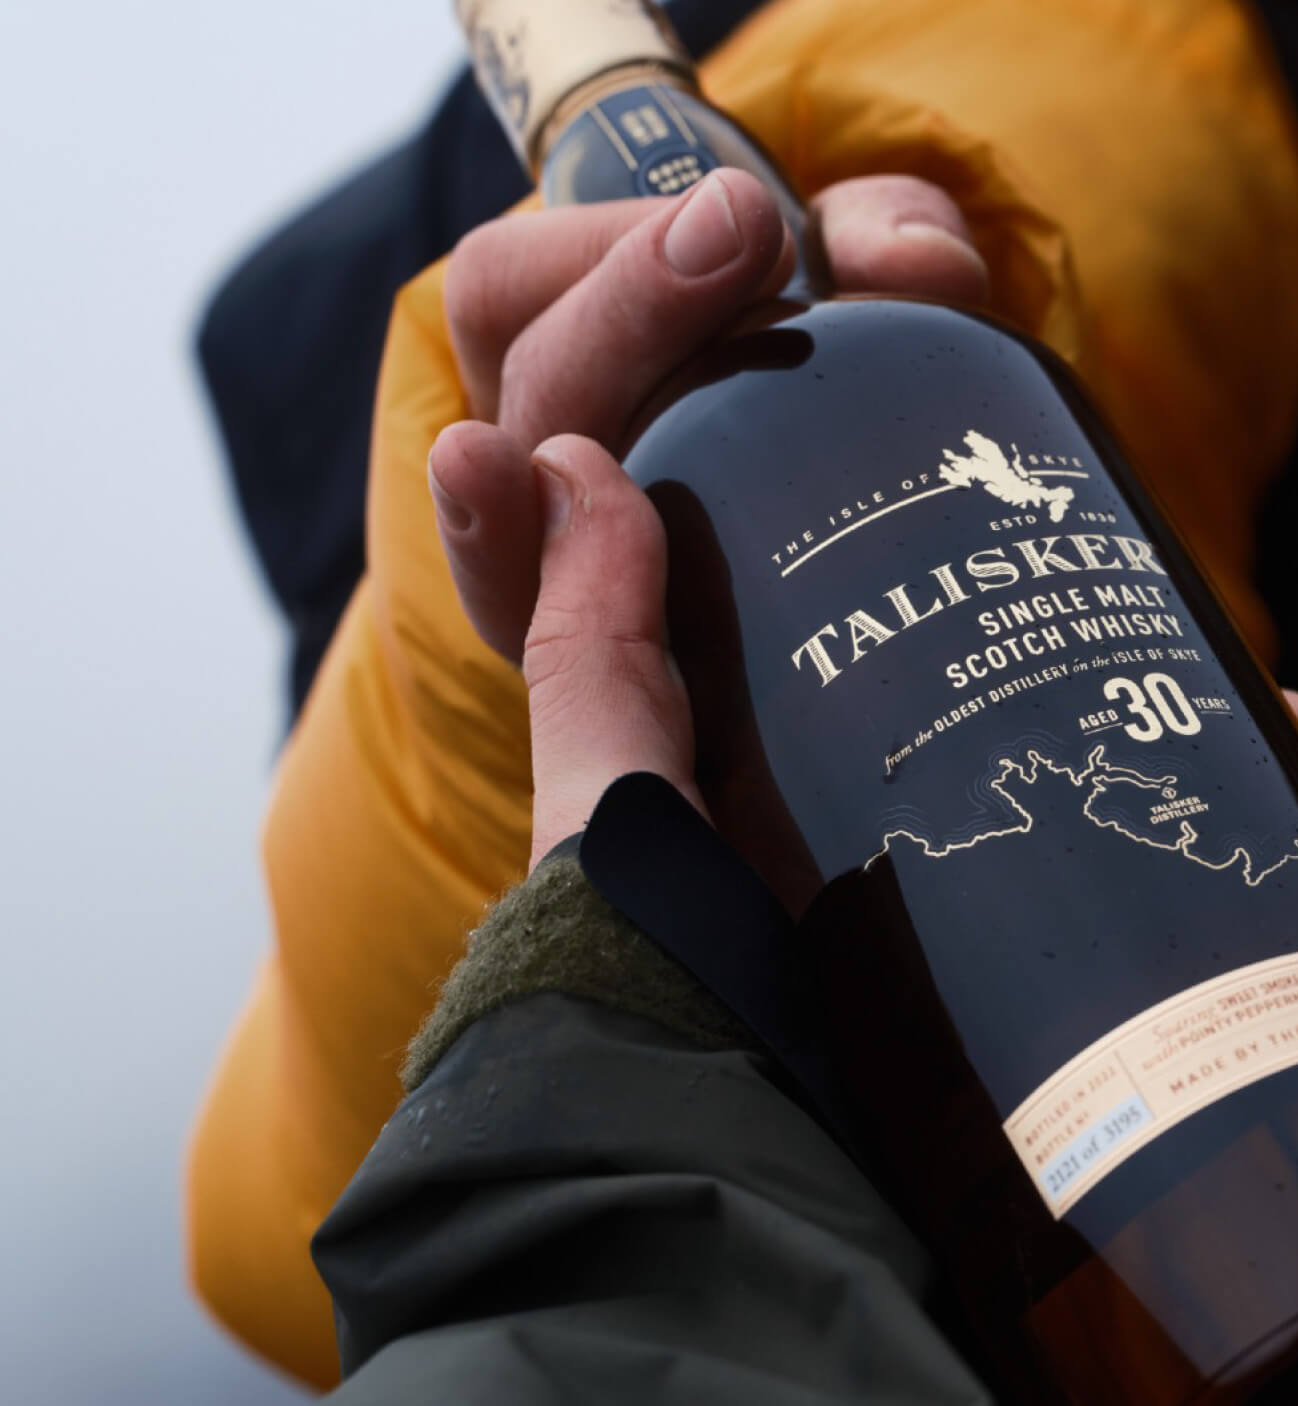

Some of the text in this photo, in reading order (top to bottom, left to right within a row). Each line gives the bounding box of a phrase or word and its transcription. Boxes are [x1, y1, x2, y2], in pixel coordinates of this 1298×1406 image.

[771, 454, 1083, 564] THE ISLE OF SKYE
[989, 514, 1037, 531] ESTD
[791, 534, 1167, 687] TALISKER
[978, 584, 1166, 637] SINGLE MALT
[946, 614, 1184, 688] SCOTCH WHISKY
[885, 648, 1202, 775] from the OLDEST DISTILLERY on the ISLE OF SKYE
[1078, 672, 1231, 742] AGED 30 YEARS
[1149, 796, 1200, 814] TALISKER
[1150, 803, 1209, 825] DISTILLERY
[1169, 1057, 1226, 1094] MADE
[1234, 1042, 1260, 1061] BY
[1025, 1099, 1071, 1147] BOTTLED
[1046, 1153, 1082, 1193] 2121
[1082, 1134, 1100, 1160] of
